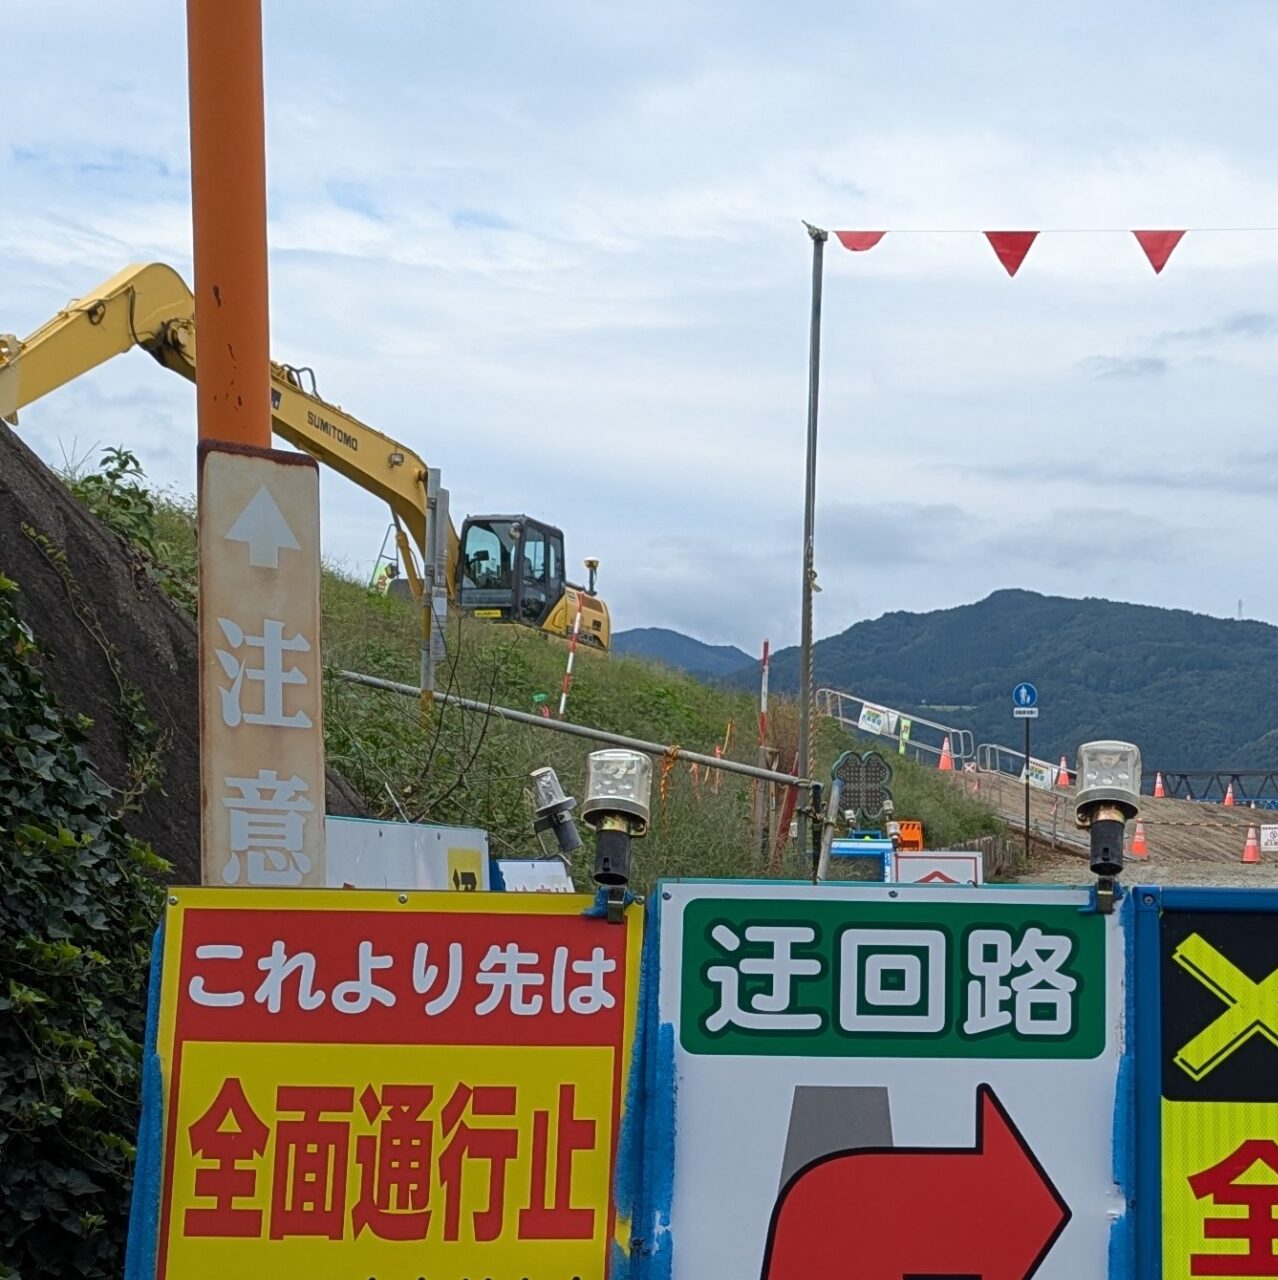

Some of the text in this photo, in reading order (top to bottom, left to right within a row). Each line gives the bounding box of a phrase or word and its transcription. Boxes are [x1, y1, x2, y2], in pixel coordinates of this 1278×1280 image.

[307, 410, 358, 451] SUMITOMO
[214, 617, 314, 885] 注意
[188, 940, 617, 1016] これより先は
[705, 924, 1077, 1035] 迂回路
[183, 1077, 598, 1242] 全面通行止
